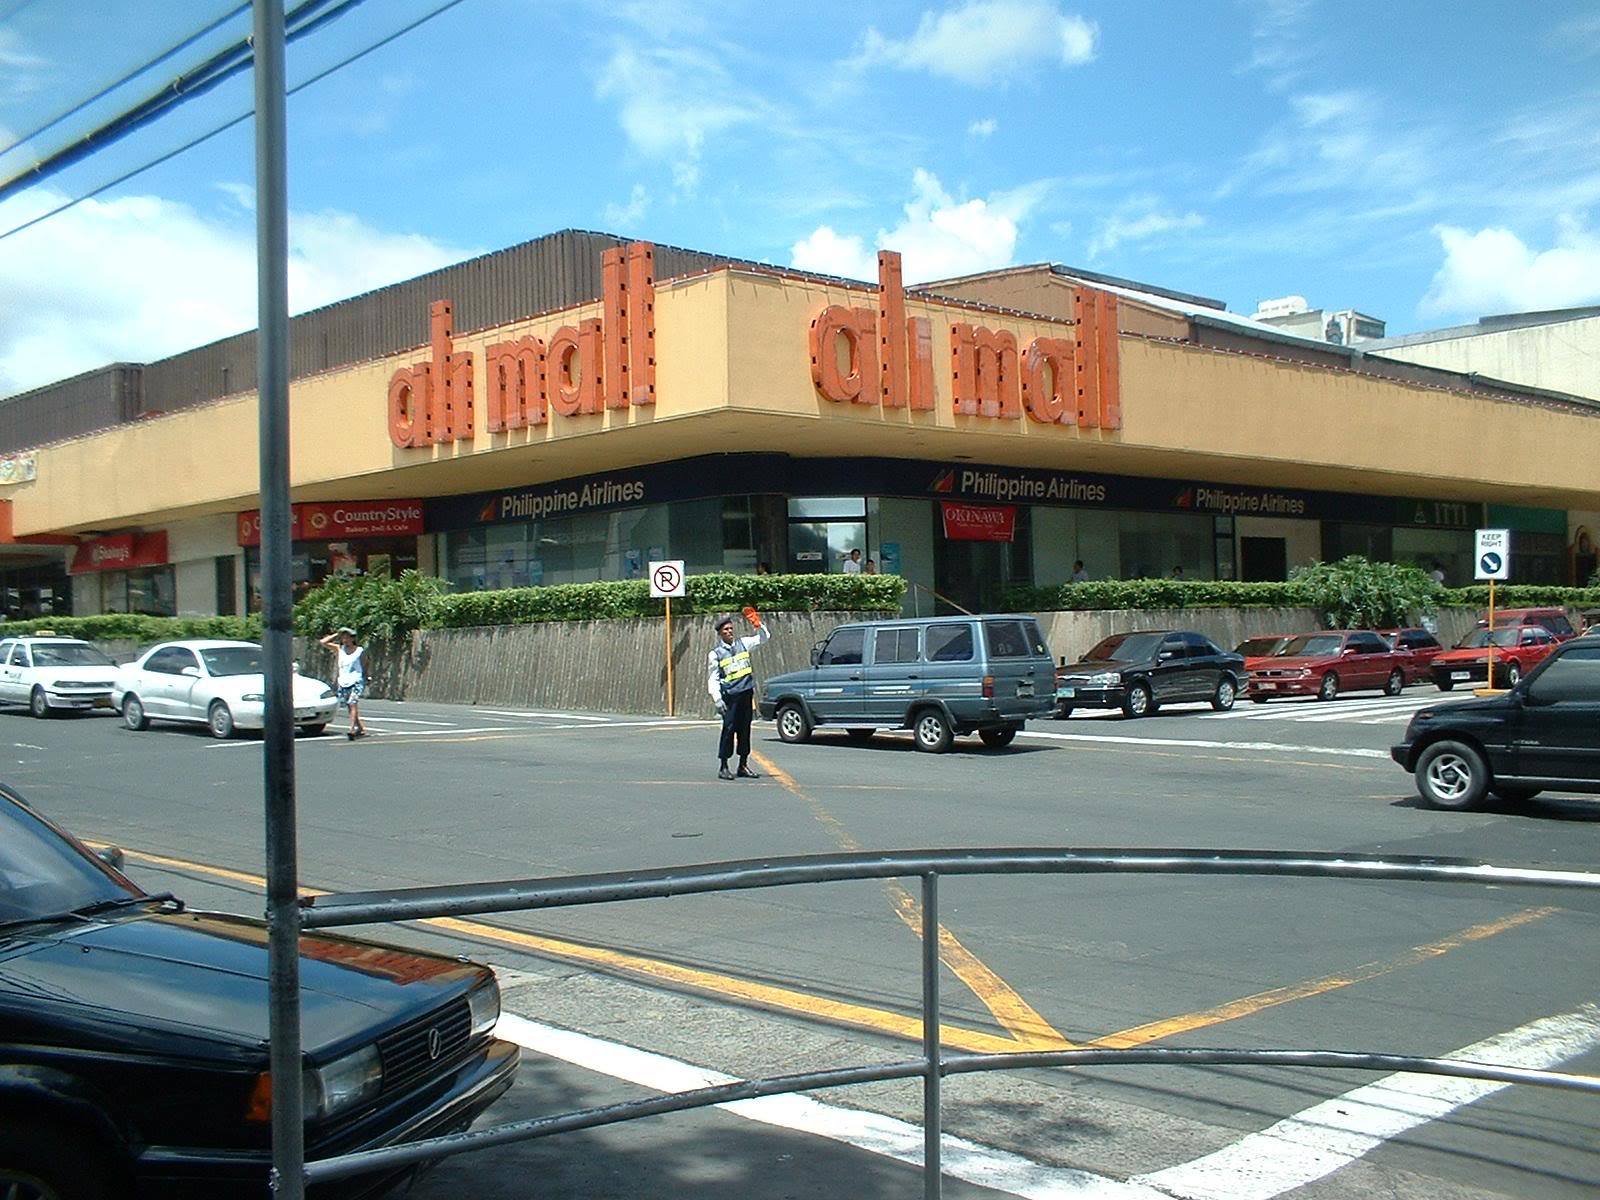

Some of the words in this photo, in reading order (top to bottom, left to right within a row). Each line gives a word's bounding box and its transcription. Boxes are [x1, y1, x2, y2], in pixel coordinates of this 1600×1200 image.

[485, 242, 656, 433] mall
[950, 287, 1121, 431] mall
[502, 490, 581, 519] Philippine
[579, 481, 645, 508] Airlines
[962, 471, 1044, 500] Philippine
[1047, 477, 1106, 501] Airlines
[1196, 488, 1259, 513] Philippine
[1259, 494, 1305, 514] Airlines
[333, 506, 421, 524] CountryStyle
[946, 508, 1005, 524] OKINAWA
